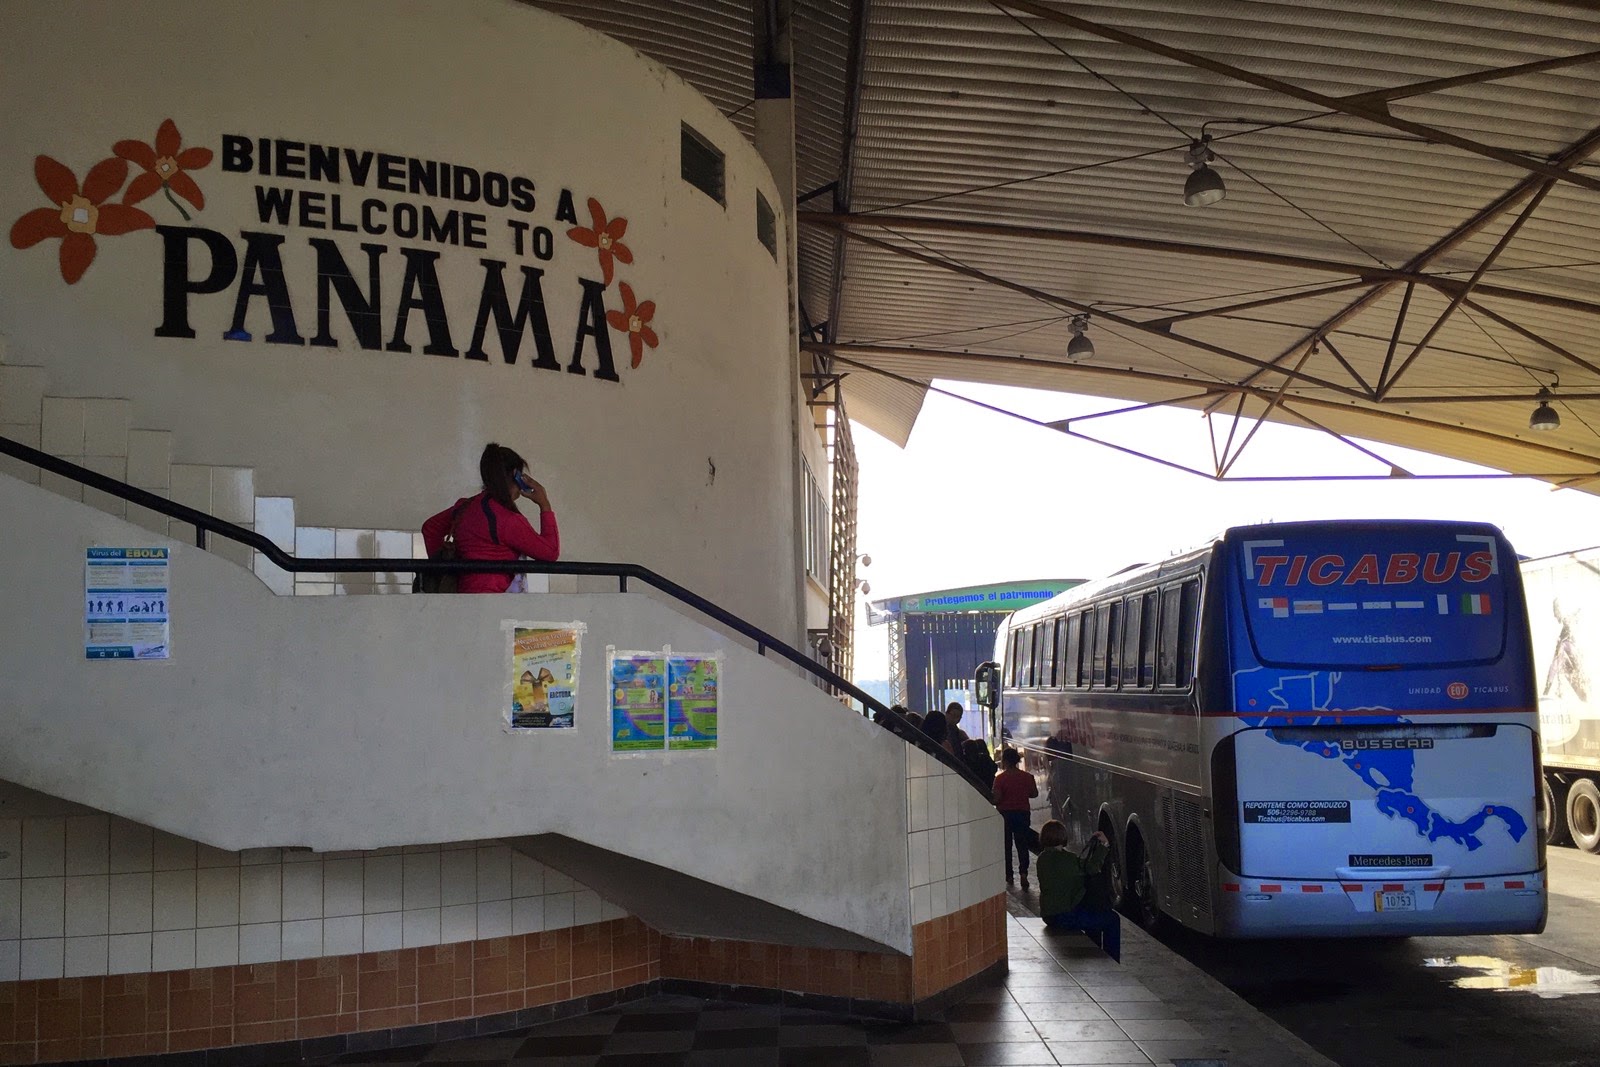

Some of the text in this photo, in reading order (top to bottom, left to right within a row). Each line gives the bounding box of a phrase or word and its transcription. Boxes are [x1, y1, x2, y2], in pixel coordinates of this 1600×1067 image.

[222, 134, 577, 226] BIENVENIDOS A
[256, 185, 554, 261] WELCOME TO
[155, 224, 620, 382] PANAMA
[126, 549, 164, 558] EBOLA
[1255, 552, 1493, 587] TICABUS
[925, 589, 1054, 606] Protegemos el patrimonio
[1332, 634, 1432, 644] www.ticabus.com
[1408, 687, 1441, 695] UNIDAD
[1474, 685, 1509, 693] TICABUS
[1342, 739, 1432, 750] BUSSCAR
[1245, 801, 1348, 809] REPORTEME COMO CONDUZCO
[1353, 856, 1430, 866] Mercedes-Benz
